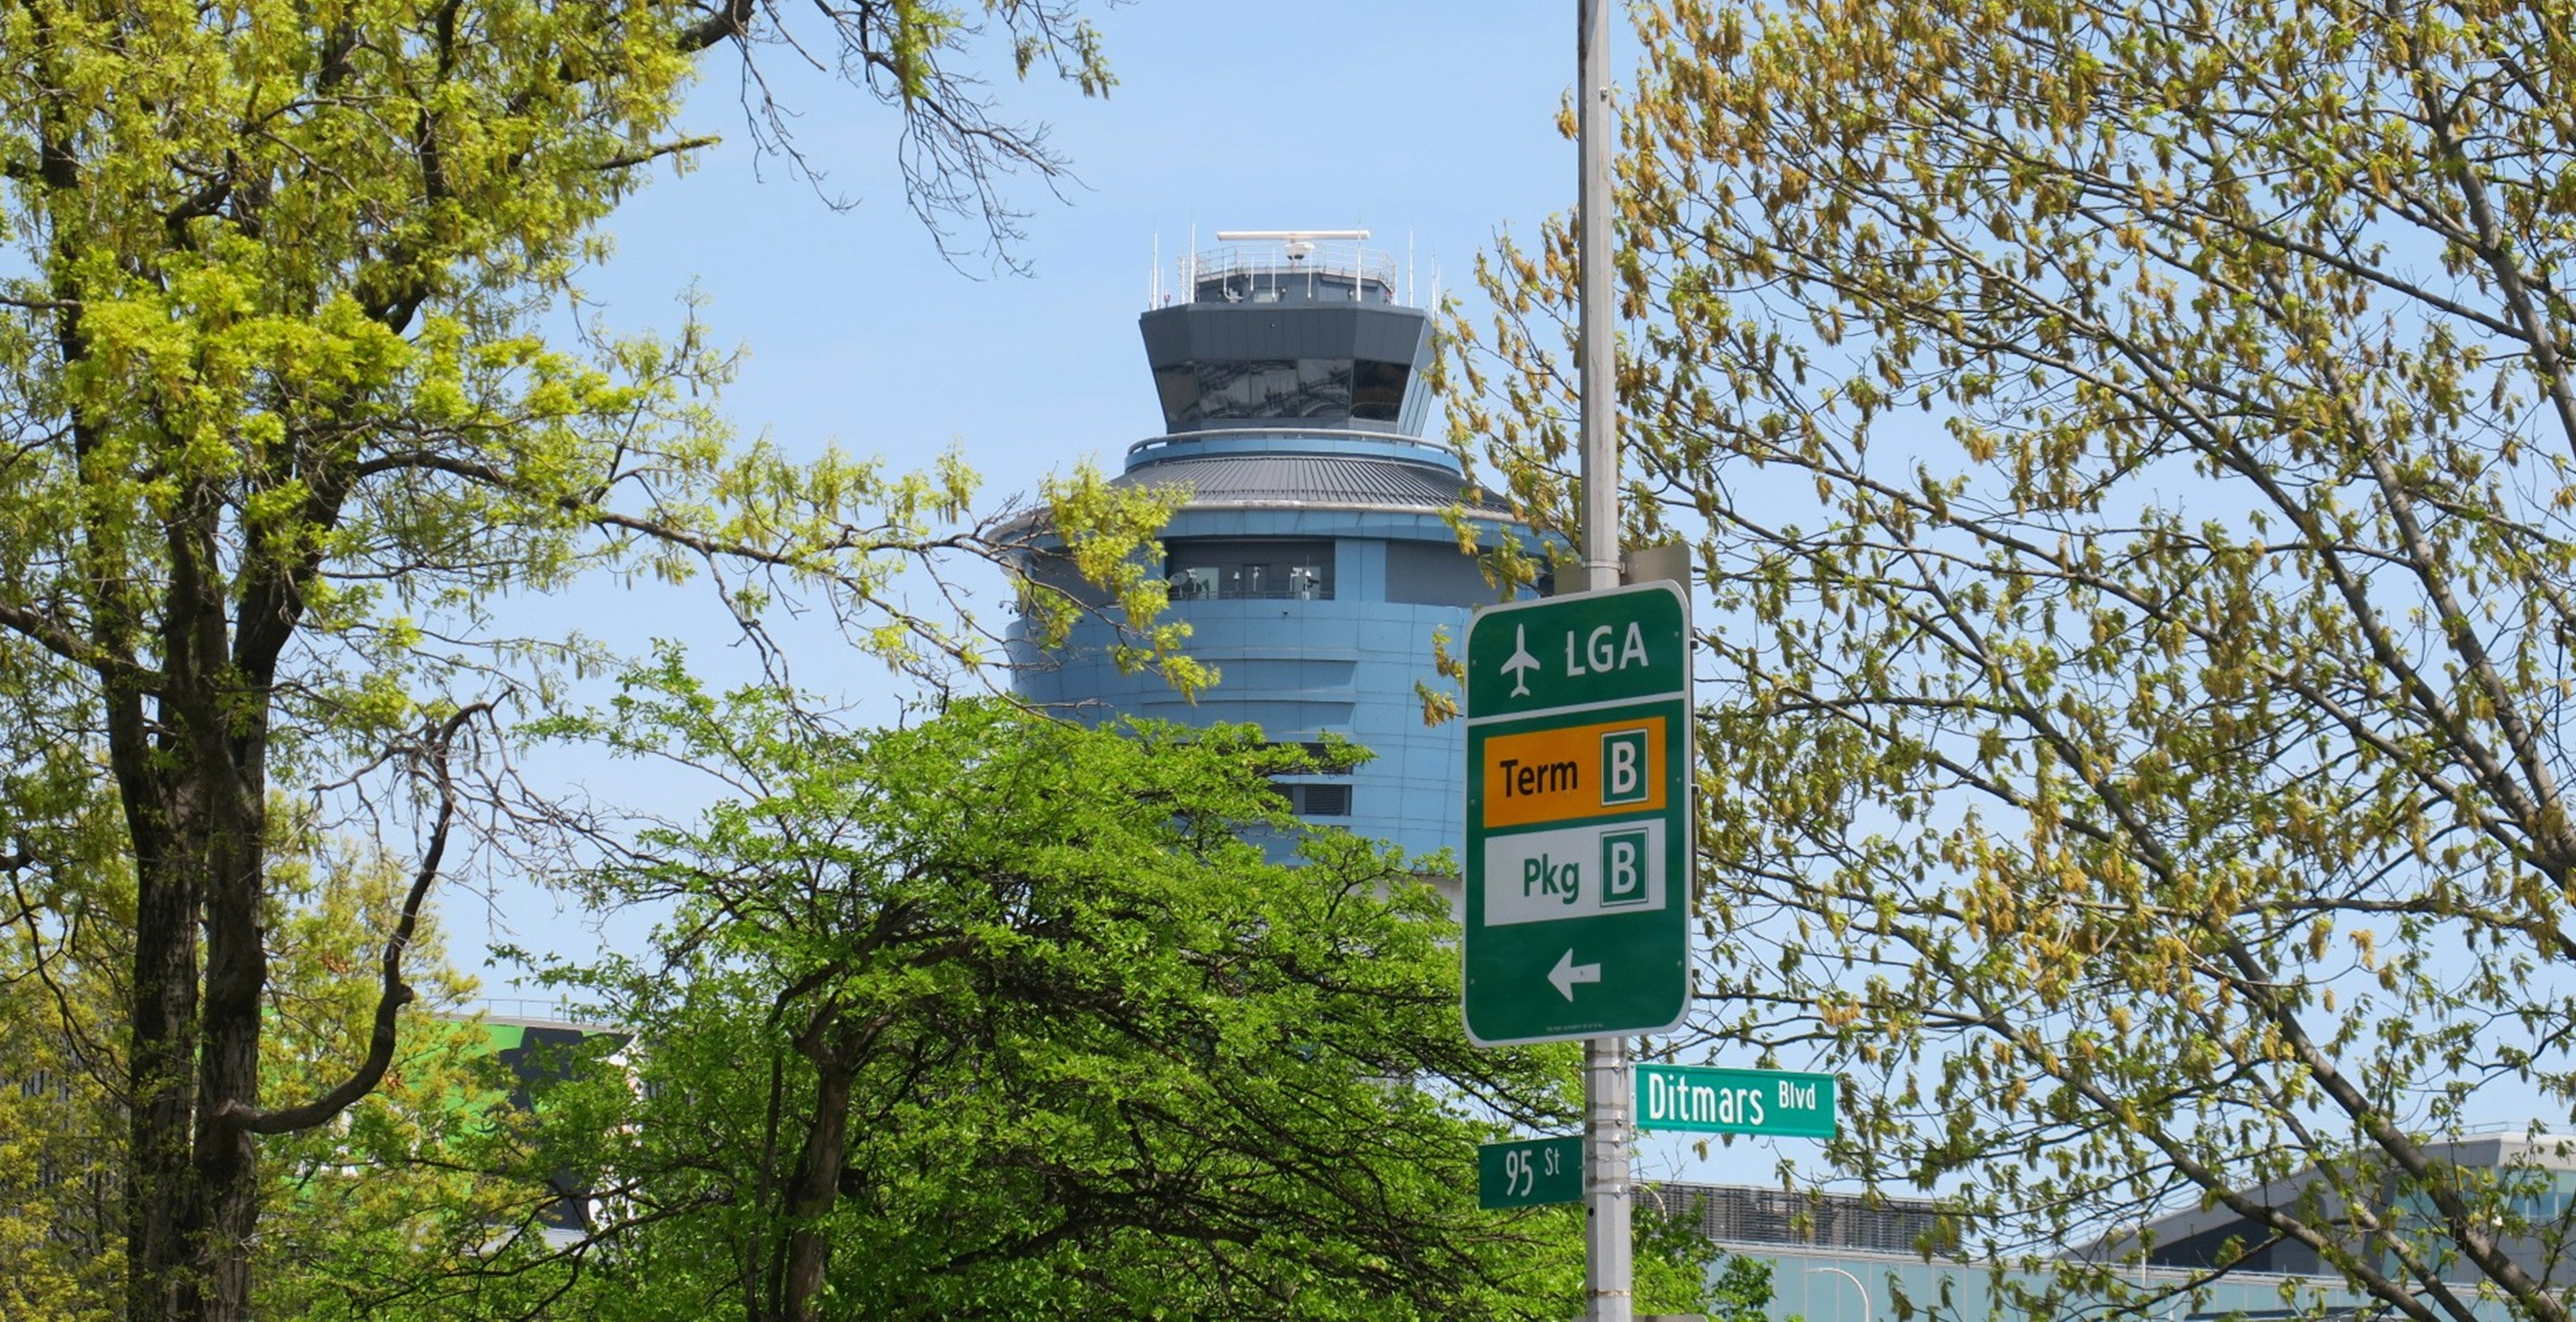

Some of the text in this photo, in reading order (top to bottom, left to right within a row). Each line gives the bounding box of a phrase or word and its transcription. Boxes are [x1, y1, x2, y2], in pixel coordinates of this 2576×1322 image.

[1565, 621, 1649, 677] LGA
[1499, 741, 1638, 798] Term B
[1523, 841, 1637, 904] Pkg B
[1648, 1072, 1817, 1126] Ditmars Blvd
[1505, 1147, 1560, 1198] 95 St
